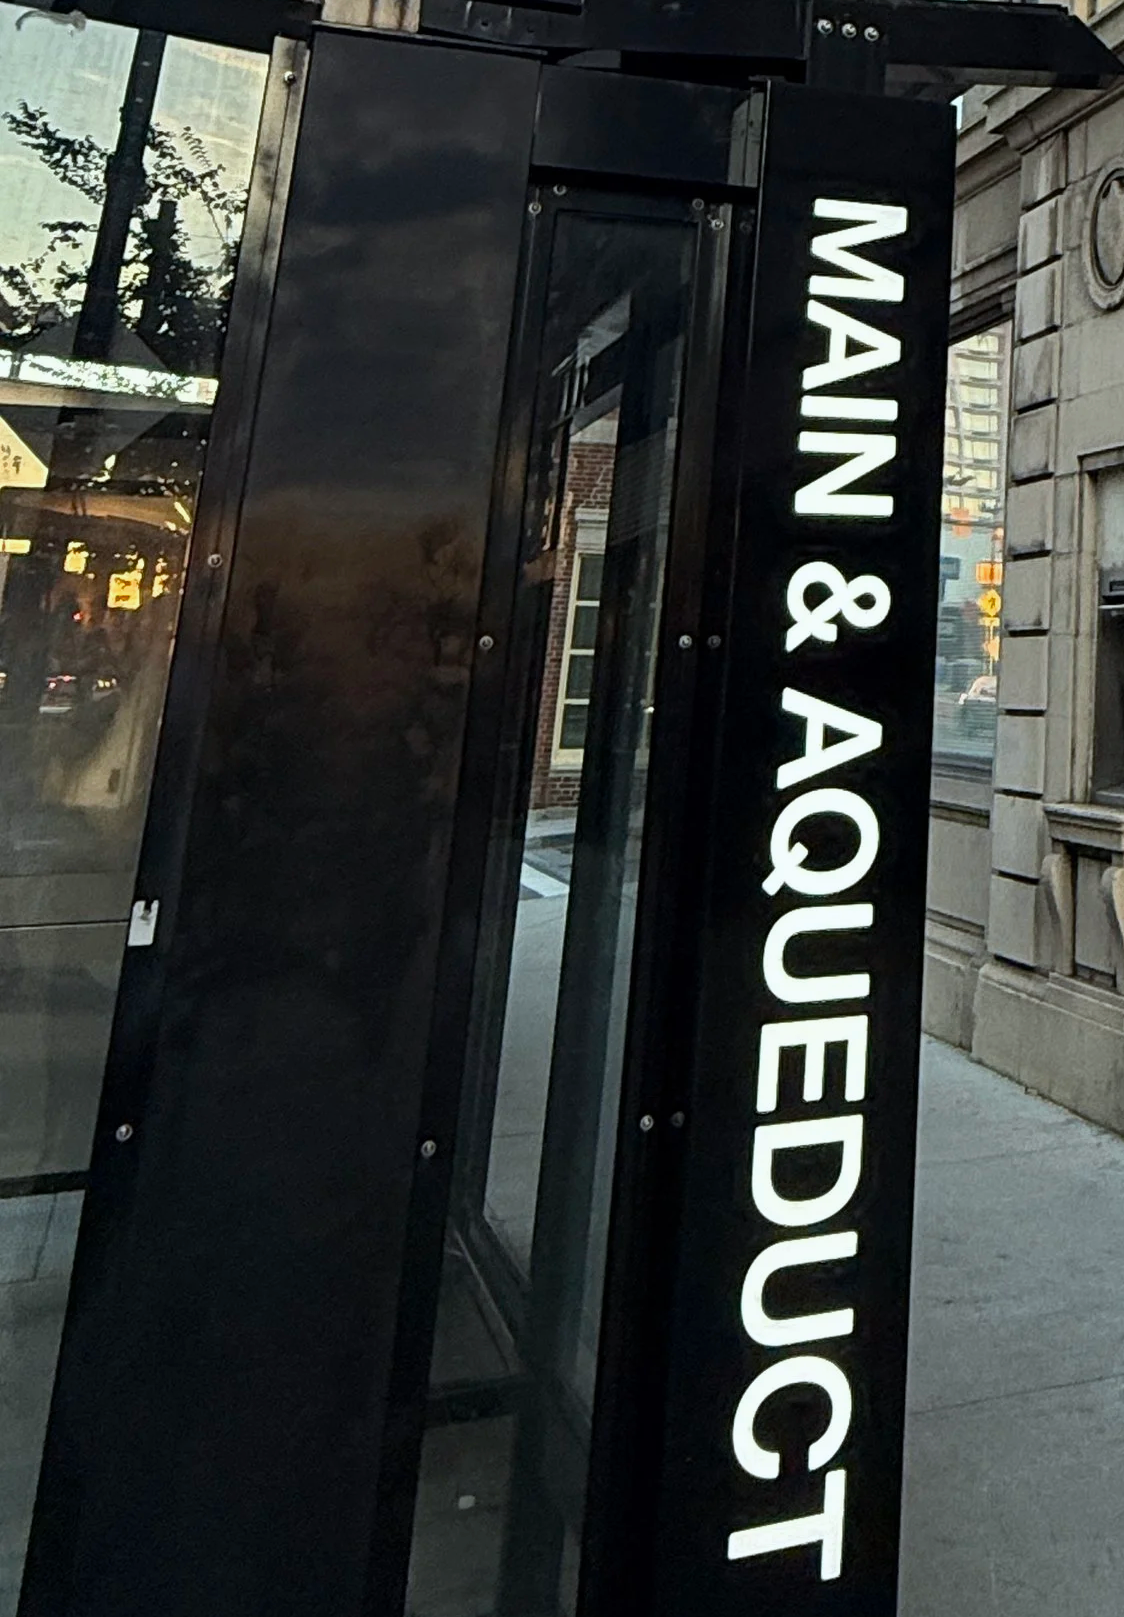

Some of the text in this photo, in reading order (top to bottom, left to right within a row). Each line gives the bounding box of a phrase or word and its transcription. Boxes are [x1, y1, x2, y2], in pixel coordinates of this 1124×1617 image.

[727, 197, 909, 1582] MAIN & AQUEDUCT
